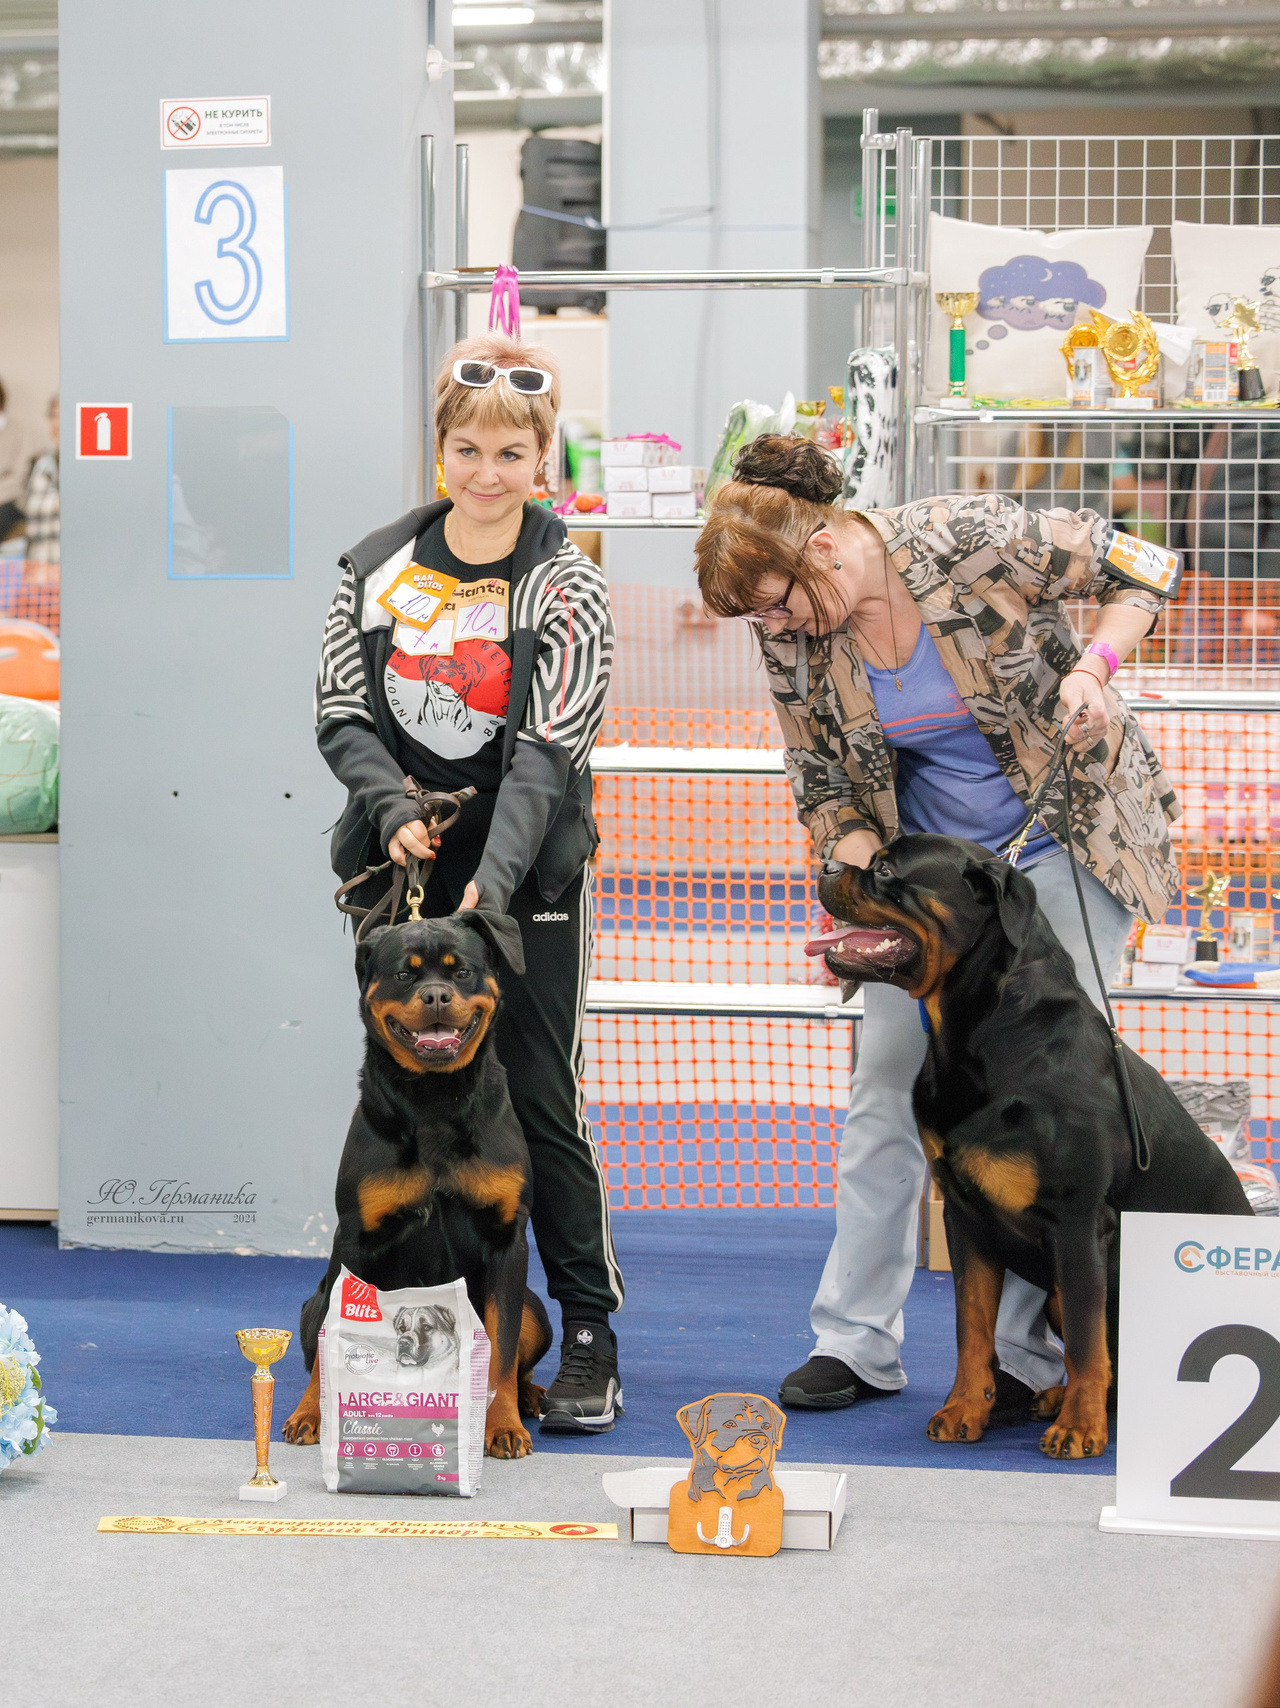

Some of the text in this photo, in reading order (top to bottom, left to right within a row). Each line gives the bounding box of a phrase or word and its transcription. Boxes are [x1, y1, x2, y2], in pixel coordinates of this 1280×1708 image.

[204, 109, 263, 119] НЕ КУРИТЬ
[194, 180, 263, 326] 3
[413, 573, 435, 583] BAN
[416, 581, 444, 591] DITOS
[400, 594, 431, 616] 10
[461, 601, 496, 633] 10
[532, 911, 570, 922] adidas
[1215, 1270, 1269, 1278] ВЫСТАВОЧНЫЙ
[344, 1303, 378, 1319] Blitz
[344, 1352, 375, 1360] Probiotic
[338, 1391, 459, 1408] LARGE&GIANT
[342, 1410, 367, 1418] ADULT
[1170, 1324, 1280, 1502] 2
[342, 1420, 384, 1435] Classic
